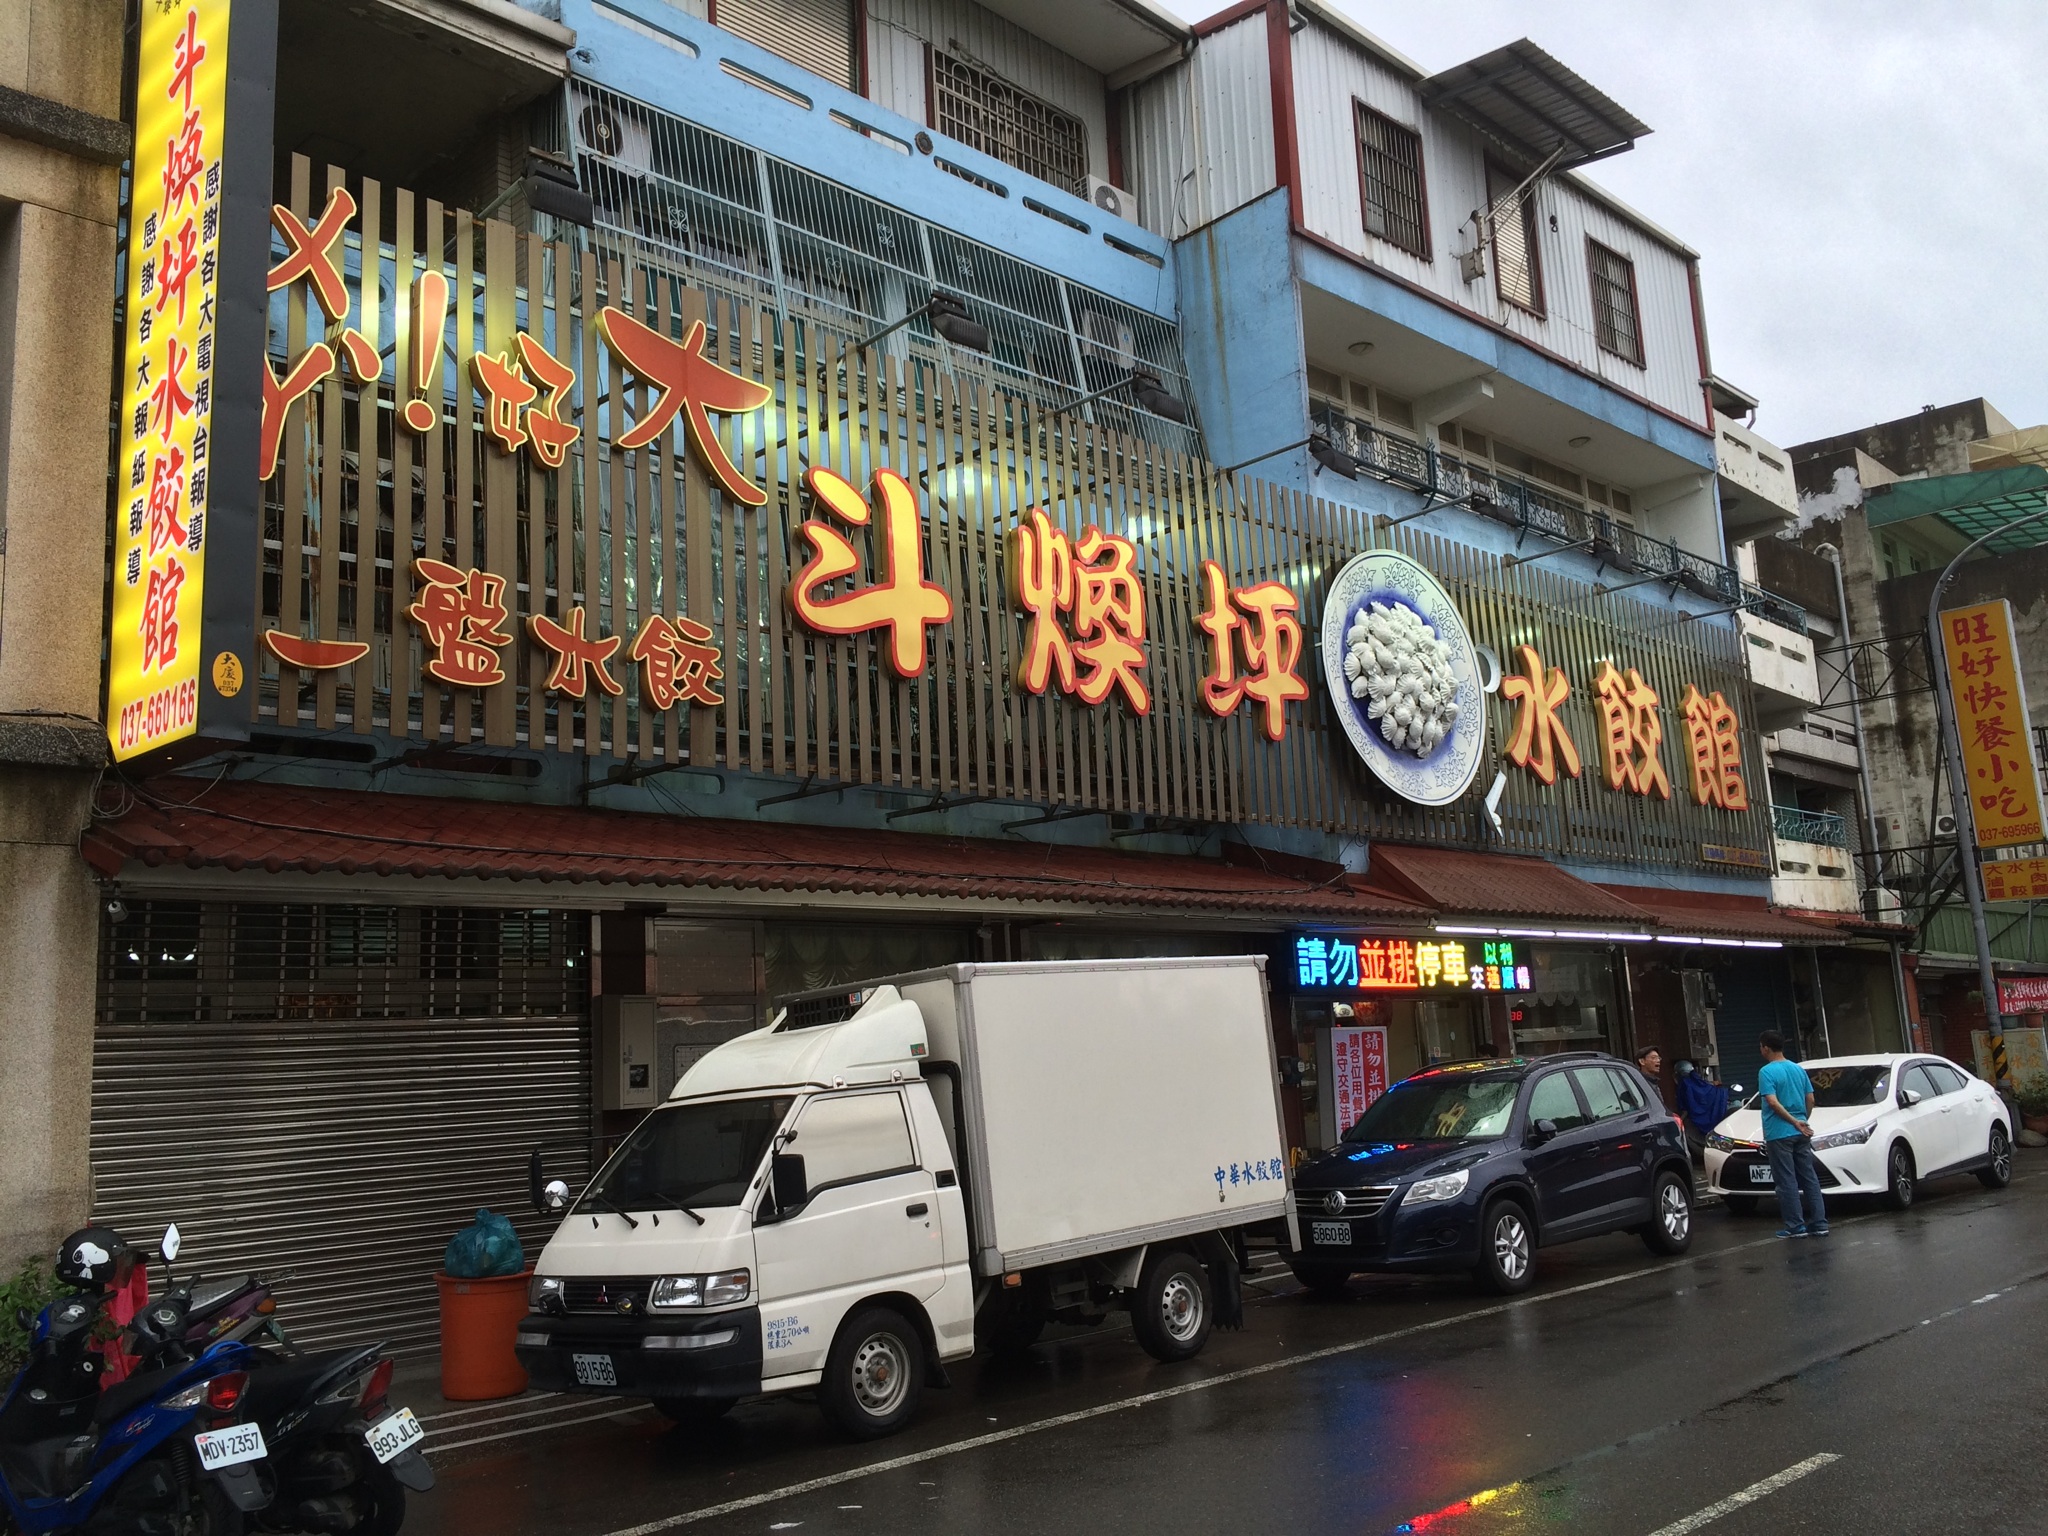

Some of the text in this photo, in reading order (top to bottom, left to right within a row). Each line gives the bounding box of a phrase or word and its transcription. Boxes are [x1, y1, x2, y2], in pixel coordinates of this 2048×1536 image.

[127, 213, 157, 585] 感謝各大報紙報導
[141, 10, 205, 675] 斗煥坪水餃館
[188, 161, 219, 552] 感謝各大電視台報導
[793, 465, 1747, 811] 斗煥坪 水餃館
[120, 678, 196, 749] 037-660166
[1953, 613, 2028, 818] 旺好快餐小吃
[1979, 822, 2041, 841] 037-695966
[2028, 860, 2048, 896] 牛肉麵
[1297, 937, 1468, 987] 請勿並排停車
[1214, 1157, 1283, 1190] 中華水餃館
